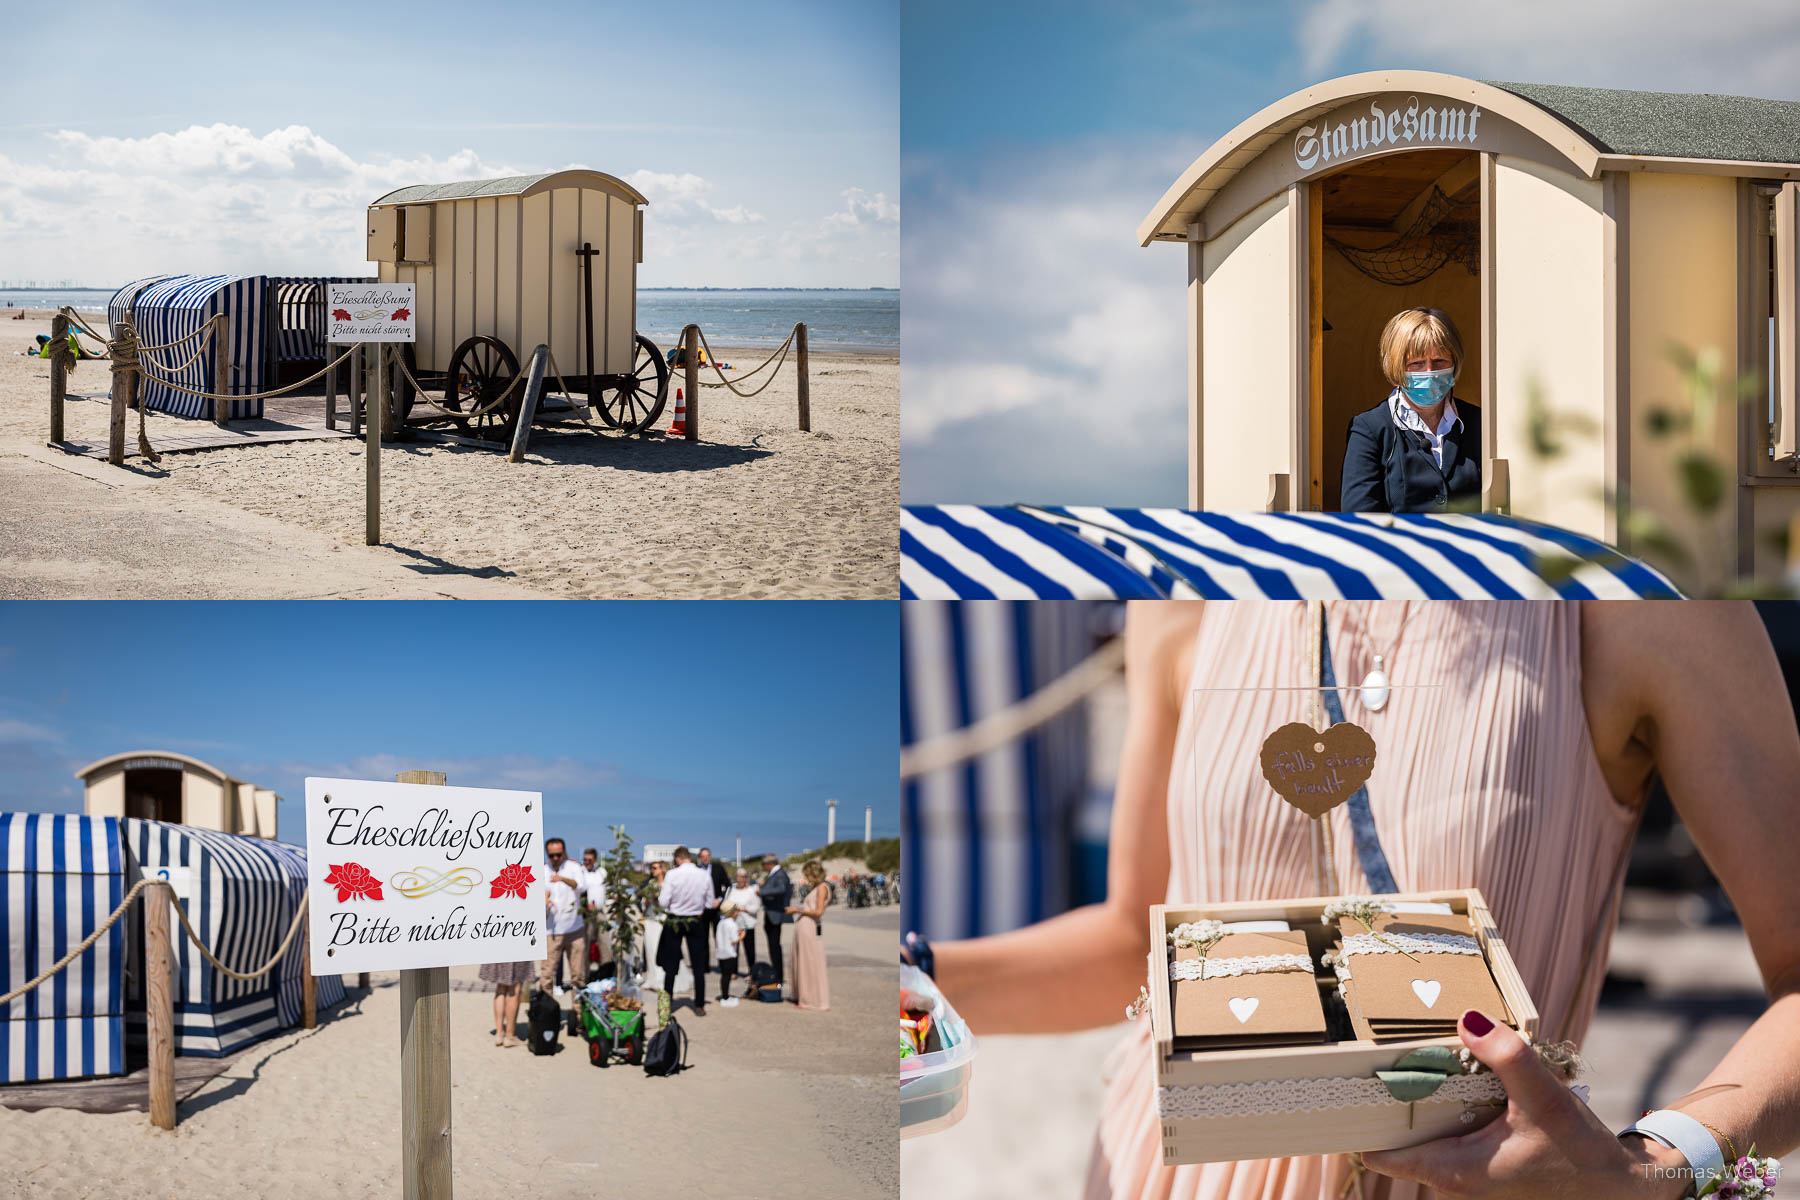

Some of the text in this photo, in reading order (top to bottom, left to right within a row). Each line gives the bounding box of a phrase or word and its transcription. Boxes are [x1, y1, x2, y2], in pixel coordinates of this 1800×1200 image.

[1294, 95, 1481, 170] Standesamt
[332, 290, 411, 310] Eheschließung
[333, 322, 411, 335] Bitte nicht stören
[1271, 750, 1371, 781] falls einer
[326, 805, 534, 868] Eheschließung
[328, 905, 537, 947] Bitte nicht stören
